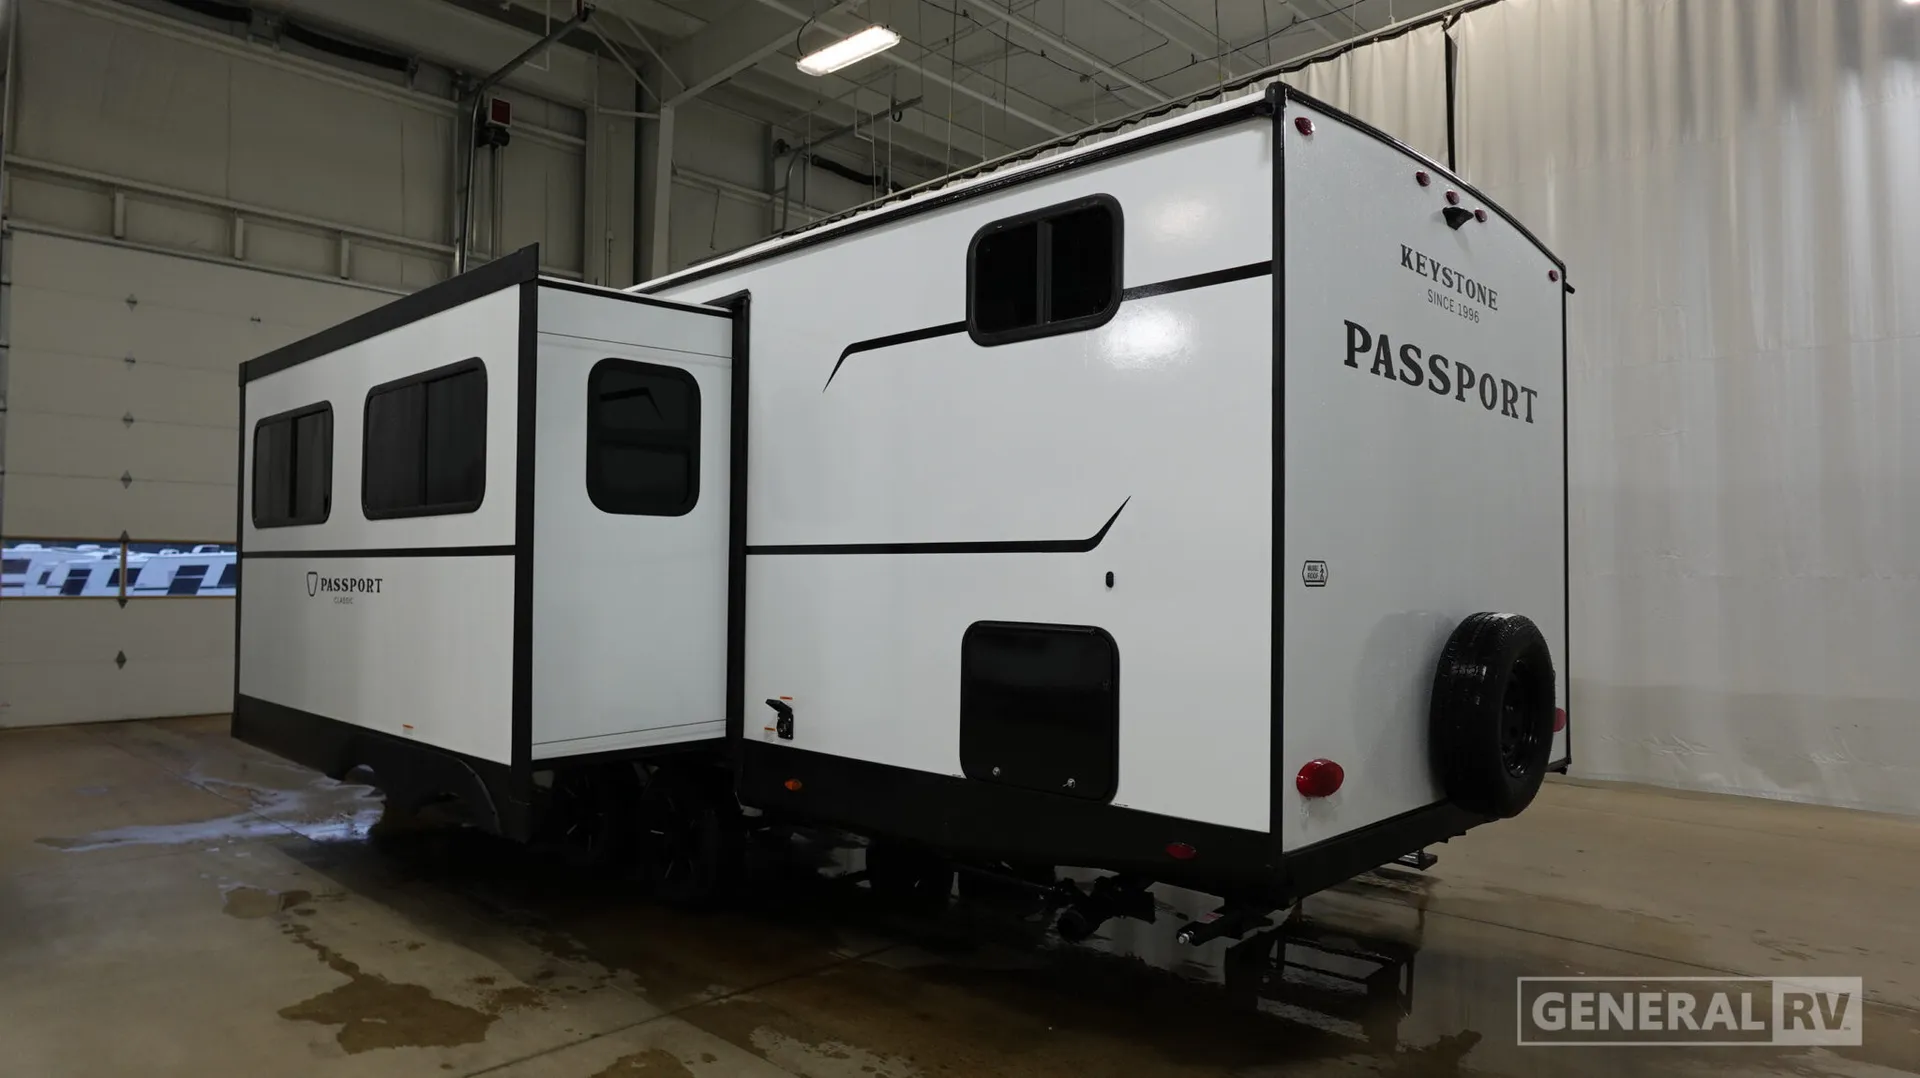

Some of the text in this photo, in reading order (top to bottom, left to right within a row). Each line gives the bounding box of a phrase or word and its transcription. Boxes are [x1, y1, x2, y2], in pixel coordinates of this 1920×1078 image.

[1400, 243, 1498, 311] KEYSTONE
[1427, 288, 1480, 324] SINCE 1996
[1344, 319, 1538, 424] PASSPORT
[320, 577, 383, 594] PASSPORT
